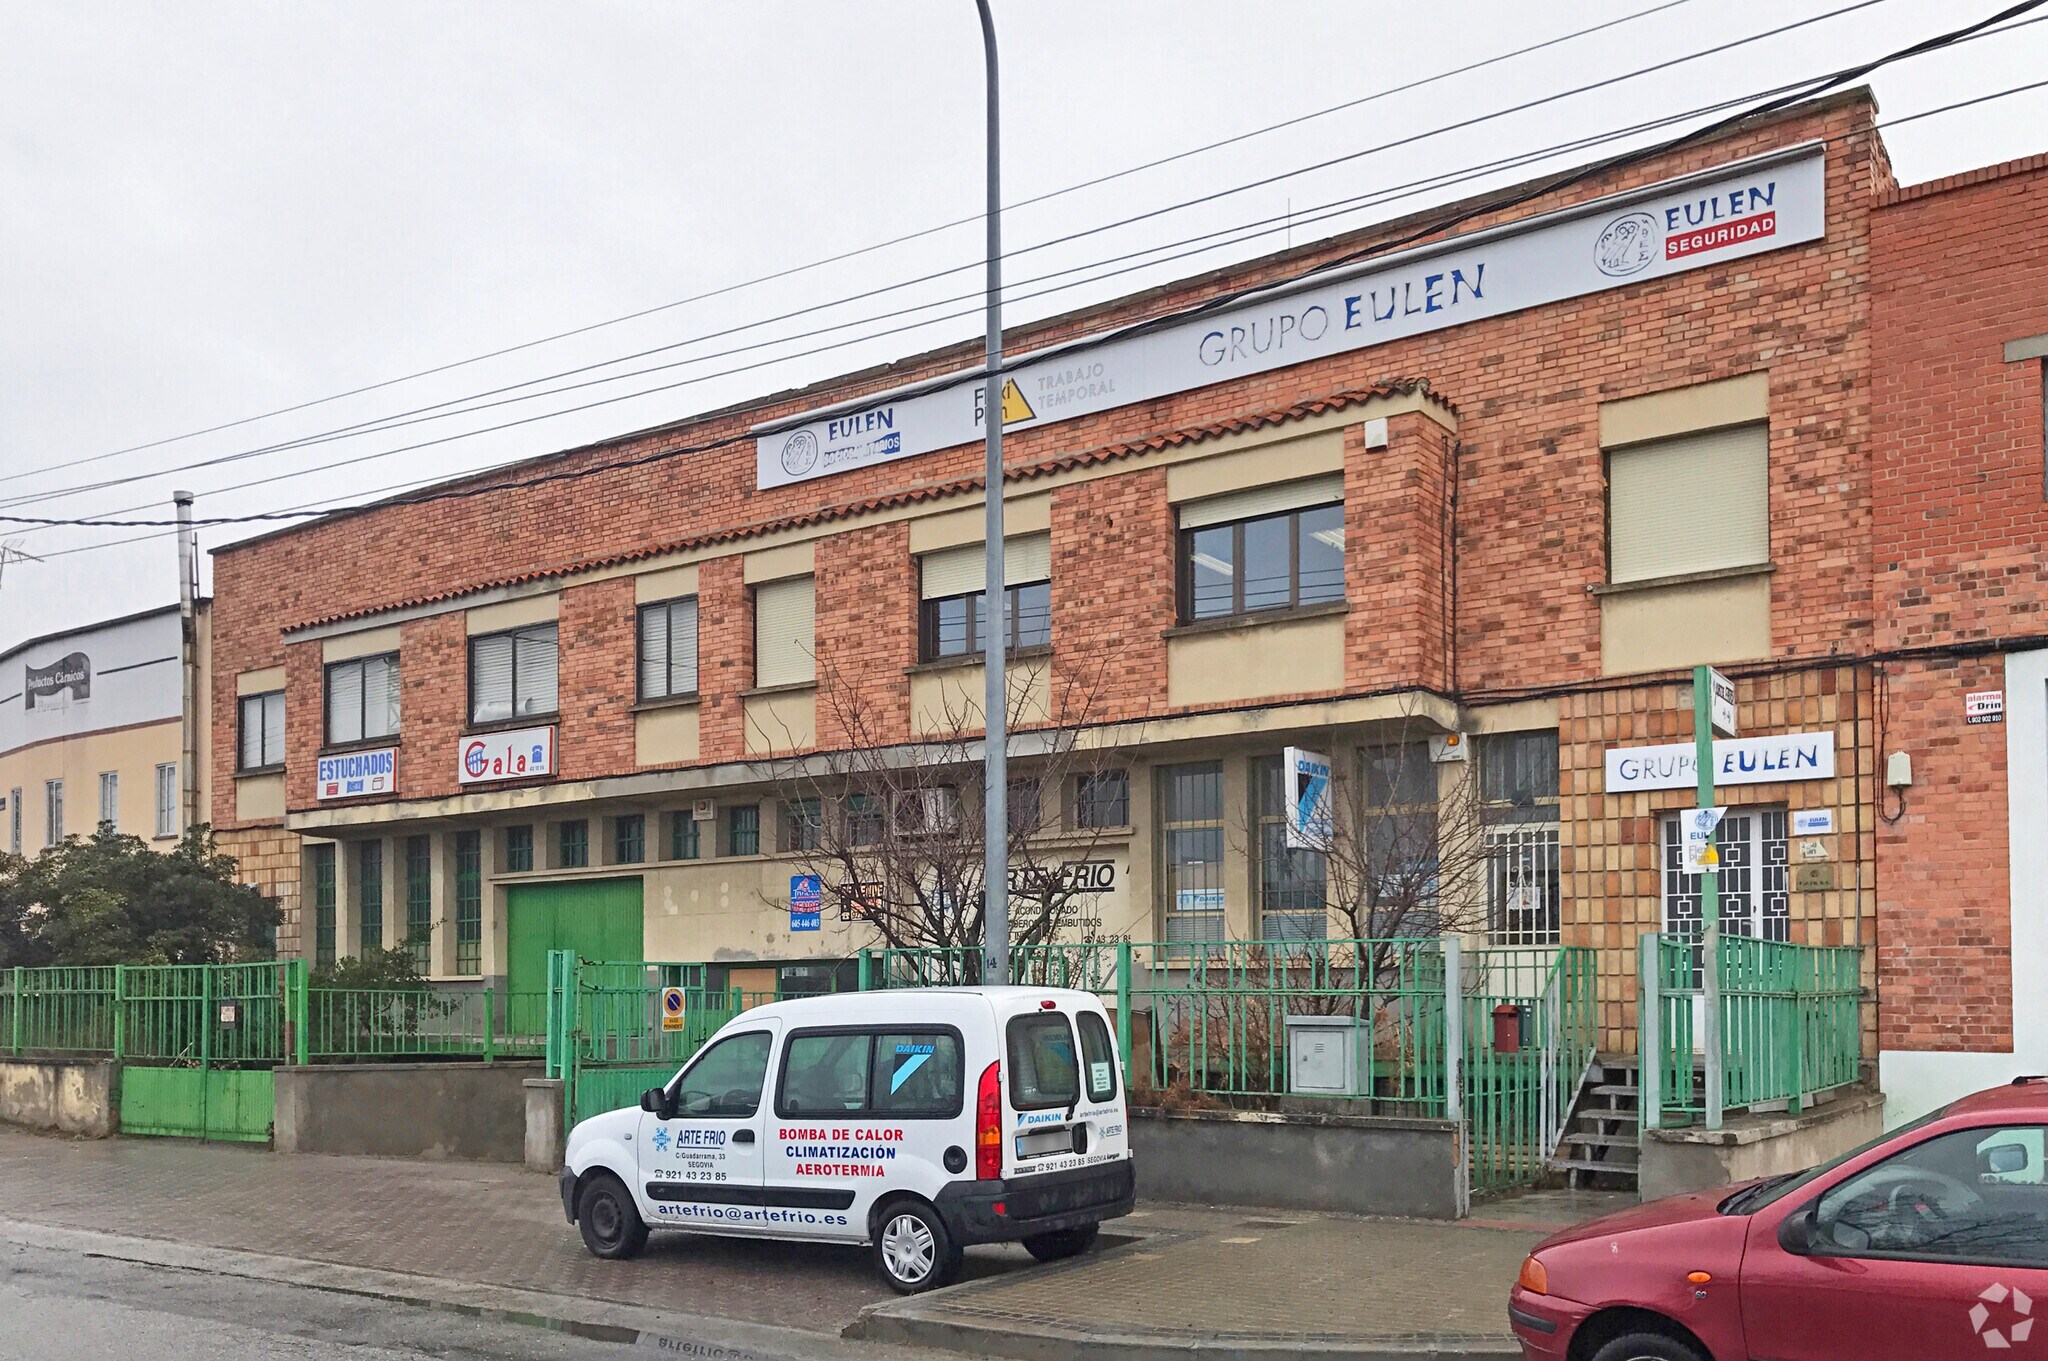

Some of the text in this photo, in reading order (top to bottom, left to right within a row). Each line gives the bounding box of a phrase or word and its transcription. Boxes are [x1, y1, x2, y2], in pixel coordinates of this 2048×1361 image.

[1665, 182, 1776, 231] EULEN
[1668, 218, 1774, 255] SEGURIDAD
[1199, 263, 1486, 366] GRUPO EULEN
[1038, 363, 1105, 392] TRABAJO
[974, 378, 1012, 408] Flxi
[1038, 379, 1116, 410] TEMPORAL
[974, 405, 1009, 427] Pln
[829, 408, 894, 441] EULEN
[55, 670, 85, 685] Cárnicos
[1967, 694, 2001, 702] alarma
[1977, 702, 2001, 710] Drin
[319, 752, 393, 781] ESTUCHADOS
[1722, 744, 1818, 774] EULEN
[1297, 760, 1330, 776] DAIKIN
[895, 1045, 935, 1054] DAIKIN
[1027, 1113, 1062, 1124] DAIKIN
[677, 1130, 726, 1145] ARTE FRIO
[779, 1128, 904, 1141] BOMBA DE CALOR
[786, 1145, 896, 1159] CLIMATIZACIÓN
[796, 1163, 885, 1177] AEROTERMIA
[1046, 1162, 1058, 1171] 921
[1059, 1160, 1068, 1169] 43
[1068, 1159, 1077, 1167] 23
[1077, 1157, 1086, 1166] 85
[1087, 1155, 1107, 1164] SEGOVIA
[665, 1170, 727, 1181] 921 43 23 85
[658, 1204, 848, 1226] artefrio@artefrio.es
